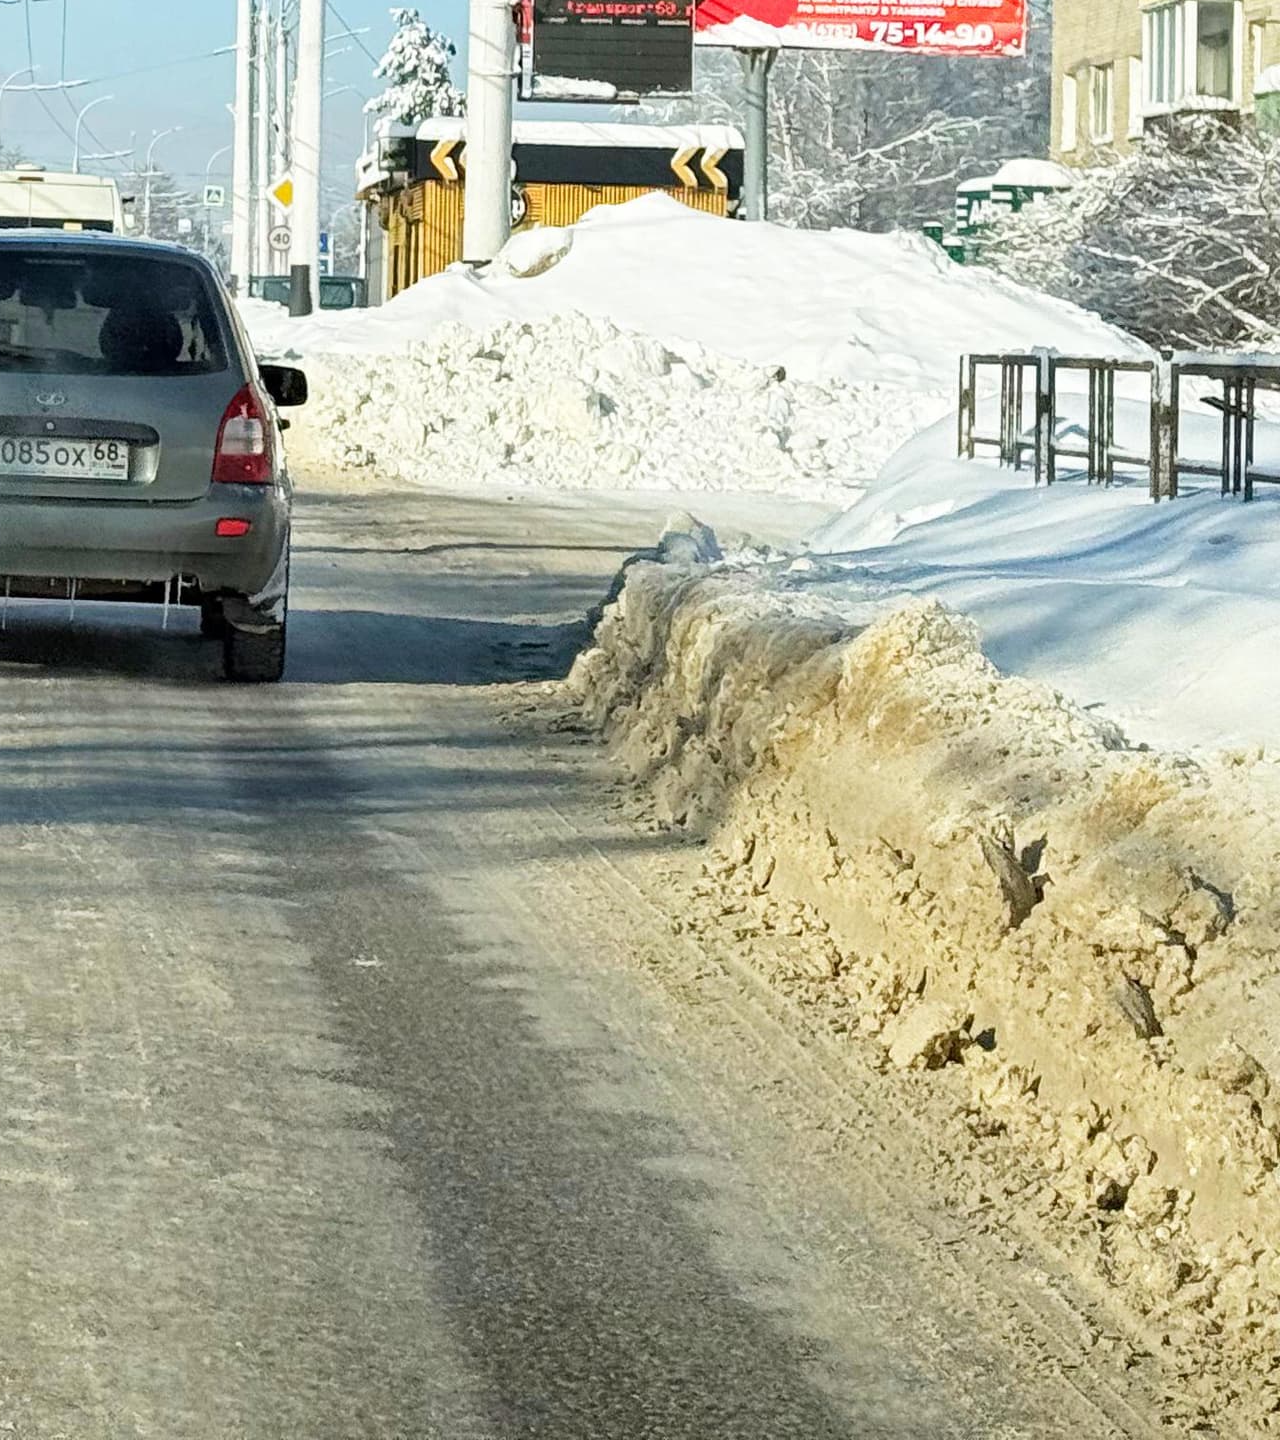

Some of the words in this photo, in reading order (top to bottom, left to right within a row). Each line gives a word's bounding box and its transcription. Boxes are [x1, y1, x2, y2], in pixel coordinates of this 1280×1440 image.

[870, 21, 994, 45] 75-14-90
[273, 233, 290, 244] 40
[94, 442, 119, 461] 68
